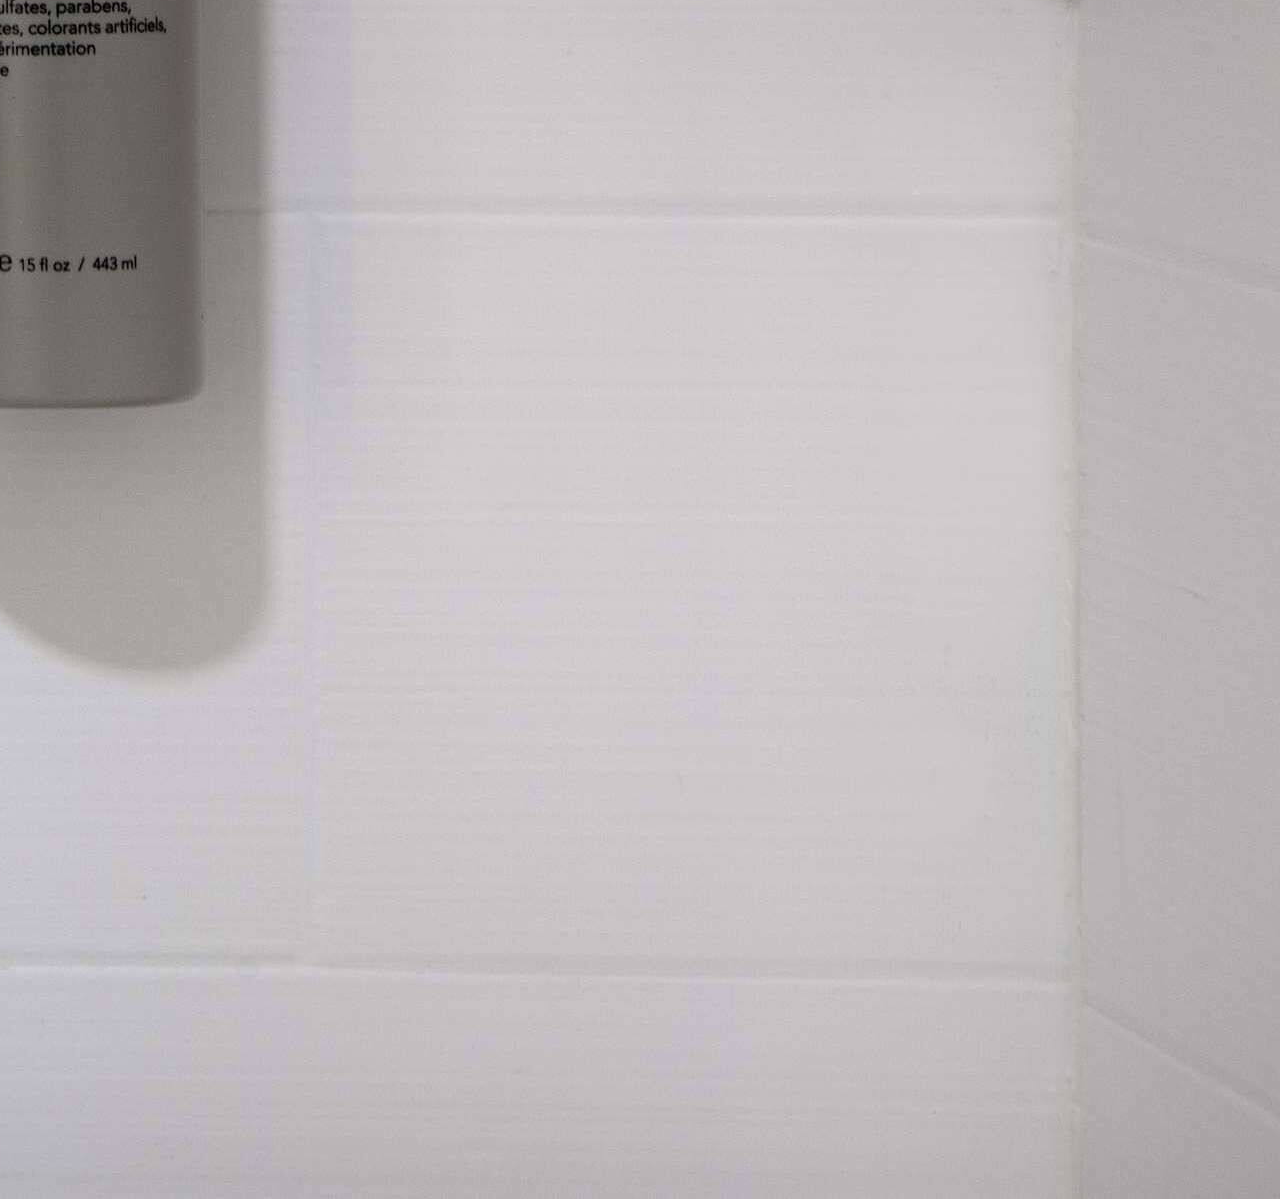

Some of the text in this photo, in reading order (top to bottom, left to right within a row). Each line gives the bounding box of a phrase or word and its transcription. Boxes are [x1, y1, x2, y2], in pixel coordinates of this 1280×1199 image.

[28, 20, 101, 35] colorants
[105, 16, 167, 34] artificiels,
[19, 258, 35, 271] 15
[40, 257, 48, 271] fl
[53, 261, 70, 271] oz
[92, 257, 118, 270] 443
[121, 255, 138, 270] ml
